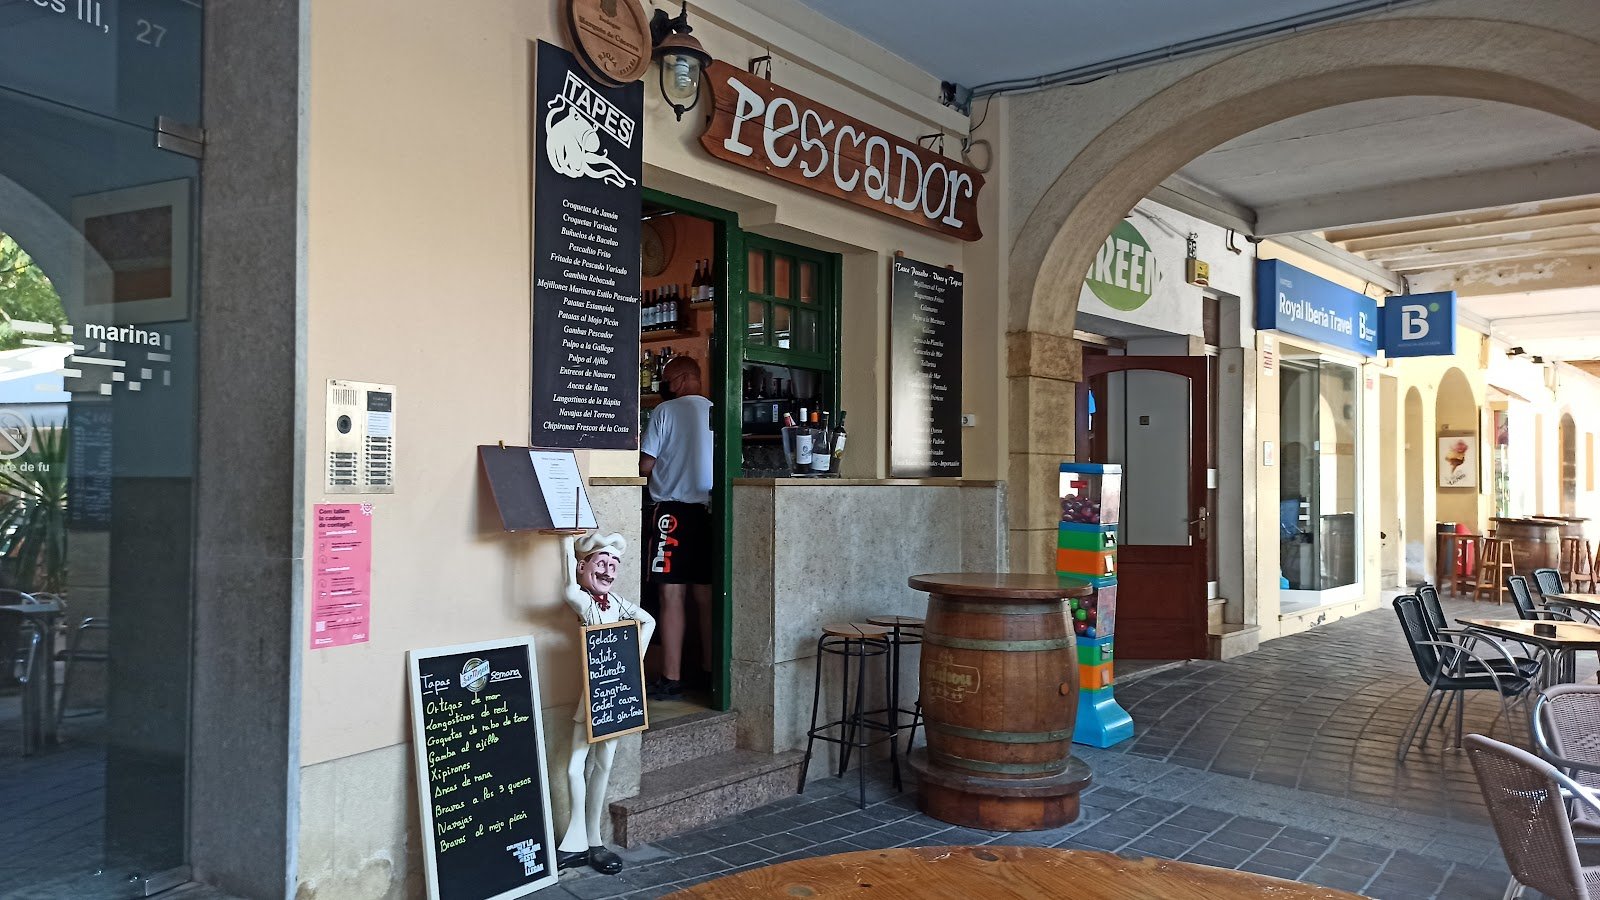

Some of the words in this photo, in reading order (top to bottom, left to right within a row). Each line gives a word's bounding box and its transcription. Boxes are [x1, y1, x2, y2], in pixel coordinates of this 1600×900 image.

[136, 19, 167, 47] 27
[569, 75, 632, 143] TAPES
[563, 199, 592, 213] Croquetas
[592, 207, 599, 215] de
[563, 213, 592, 227] Croquetas
[593, 220, 618, 233] Variadas
[561, 227, 587, 240] Buñuelos
[596, 236, 619, 246] Bacalao
[568, 243, 596, 255] Pescadito
[597, 249, 611, 258] Frito
[581, 259, 604, 270] Pescado
[606, 264, 627, 275] Variado
[1086, 234, 1164, 295] REEN
[563, 269, 588, 281] Gambita
[589, 274, 616, 286] Rebozada
[537, 279, 568, 291] Mejillones
[569, 284, 596, 296] Marinera
[596, 289, 612, 299] Estilo
[613, 292, 638, 303] Pescador
[563, 297, 585, 307] Patatas
[558, 310, 579, 321] Patatas
[587, 315, 602, 325] Mojo
[1279, 292, 1304, 322] Royal
[1305, 302, 1328, 328] Iberia
[1329, 310, 1352, 335] Travel
[1402, 305, 1429, 340] B
[85, 321, 160, 346] marina
[563, 325, 587, 336] Gambas
[588, 329, 613, 339] Pescador
[562, 339, 579, 349] Pulpo
[592, 343, 614, 354] Gallega
[568, 354, 585, 365] Pulpo
[593, 357, 608, 366] Ajillo
[560, 367, 584, 376] Entrecot
[593, 370, 616, 380] Navarra
[567, 382, 585, 390] Ancas
[594, 384, 608, 392] Rana
[553, 394, 587, 404] Langostinos
[559, 408, 582, 419] Navajas
[583, 410, 592, 418] del
[594, 410, 615, 419] Terreno
[543, 421, 575, 432] Chipirones
[576, 423, 598, 432] Frescos
[20, 462, 34, 472] de
[589, 629, 618, 650] Gelats
[589, 647, 617, 665] batuts
[590, 661, 626, 680] naturals
[420, 674, 451, 695] Tapas
[426, 697, 462, 716] Ortigas
[471, 693, 481, 705] de
[619, 696, 639, 705] cava
[480, 704, 490, 718] de
[469, 724, 477, 735] de
[482, 720, 500, 732] rabo
[503, 715, 511, 727] de
[428, 747, 456, 768] Gamba
[461, 741, 469, 753] al
[475, 732, 499, 752] ajillo
[431, 761, 470, 783] Xipirones
[434, 784, 458, 798] Ancas
[462, 774, 472, 788] de
[474, 771, 493, 782] rana
[435, 801, 465, 818] Bravas
[483, 787, 494, 800] los
[499, 784, 505, 793] 3
[507, 777, 531, 795] quesos
[437, 815, 473, 836] Navajas
[440, 834, 466, 853] Bravas
[475, 824, 484, 837] al
[489, 820, 505, 833] mojo
